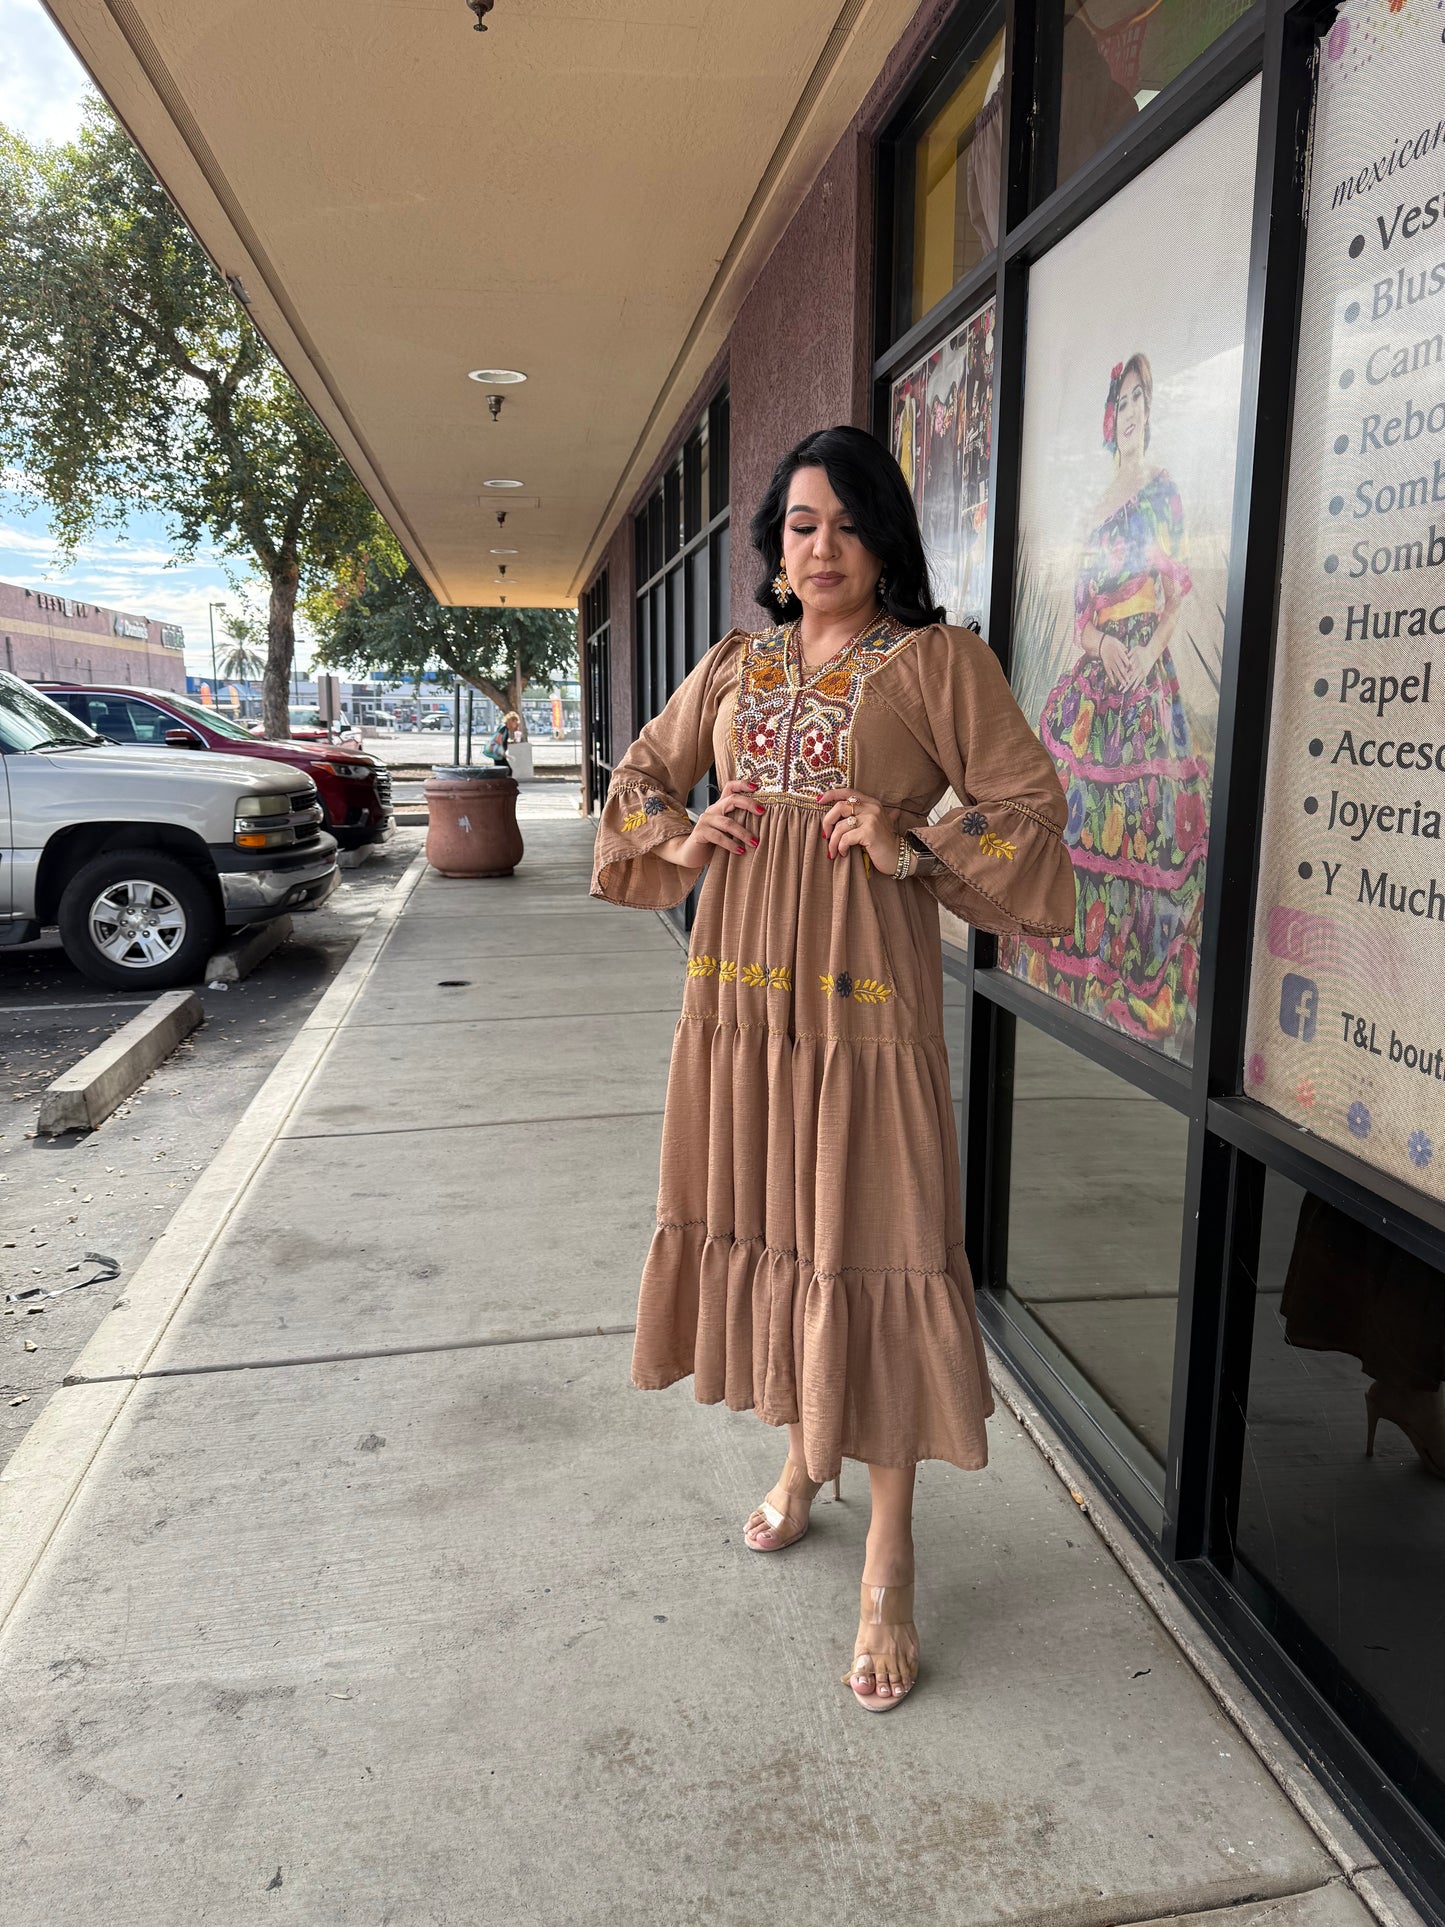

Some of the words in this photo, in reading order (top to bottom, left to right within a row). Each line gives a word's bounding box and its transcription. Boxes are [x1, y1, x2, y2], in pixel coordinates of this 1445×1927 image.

[1365, 334, 1443, 386] Cam
[1359, 400, 1445, 455] Rebo
[1349, 524, 1445, 578] Somb
[1345, 604, 1445, 641] Hurac
[1339, 661, 1432, 717] Papel
[1328, 790, 1441, 841] Joyeria
[1322, 861, 1342, 895] Y
[1357, 868, 1445, 922] Much
[1341, 1011, 1382, 1056] T&L
